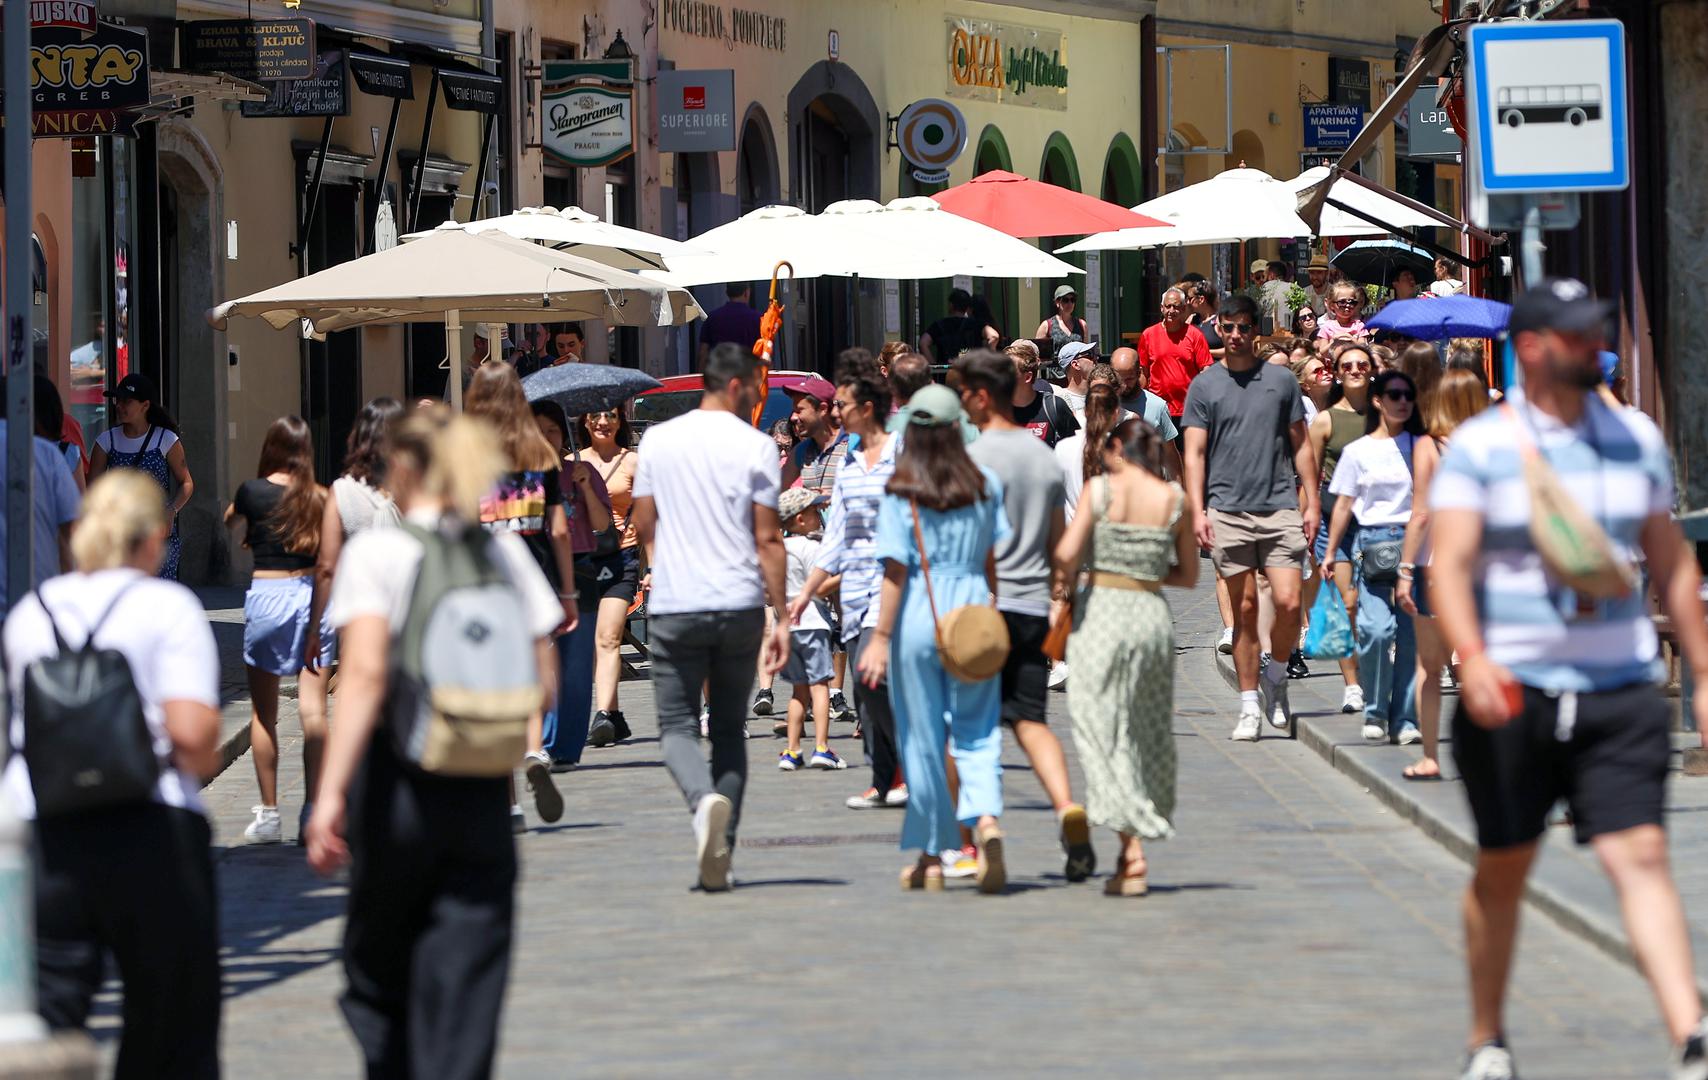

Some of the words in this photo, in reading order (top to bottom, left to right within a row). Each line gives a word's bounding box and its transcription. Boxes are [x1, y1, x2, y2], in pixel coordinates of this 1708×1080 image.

[31, 1, 89, 24] ujsko
[262, 34, 305, 46] KLJUČ
[952, 28, 1005, 89] OAZA
[31, 46, 142, 88] NTA
[294, 78, 339, 88] Manikura
[35, 91, 111, 102] GREB
[290, 89, 320, 101] Trajni
[324, 89, 340, 99] lak
[294, 102, 311, 112] Gel
[314, 102, 340, 111] nokti
[1308, 106, 1359, 116] APARTMAN
[31, 112, 107, 133] VNICA
[549, 102, 625, 134] Staropramen
[661, 113, 729, 128] SUPERIORE
[1310, 116, 1357, 126] MARINAC
[1420, 111, 1450, 126] Lap
[574, 142, 601, 150] PRAGUE
